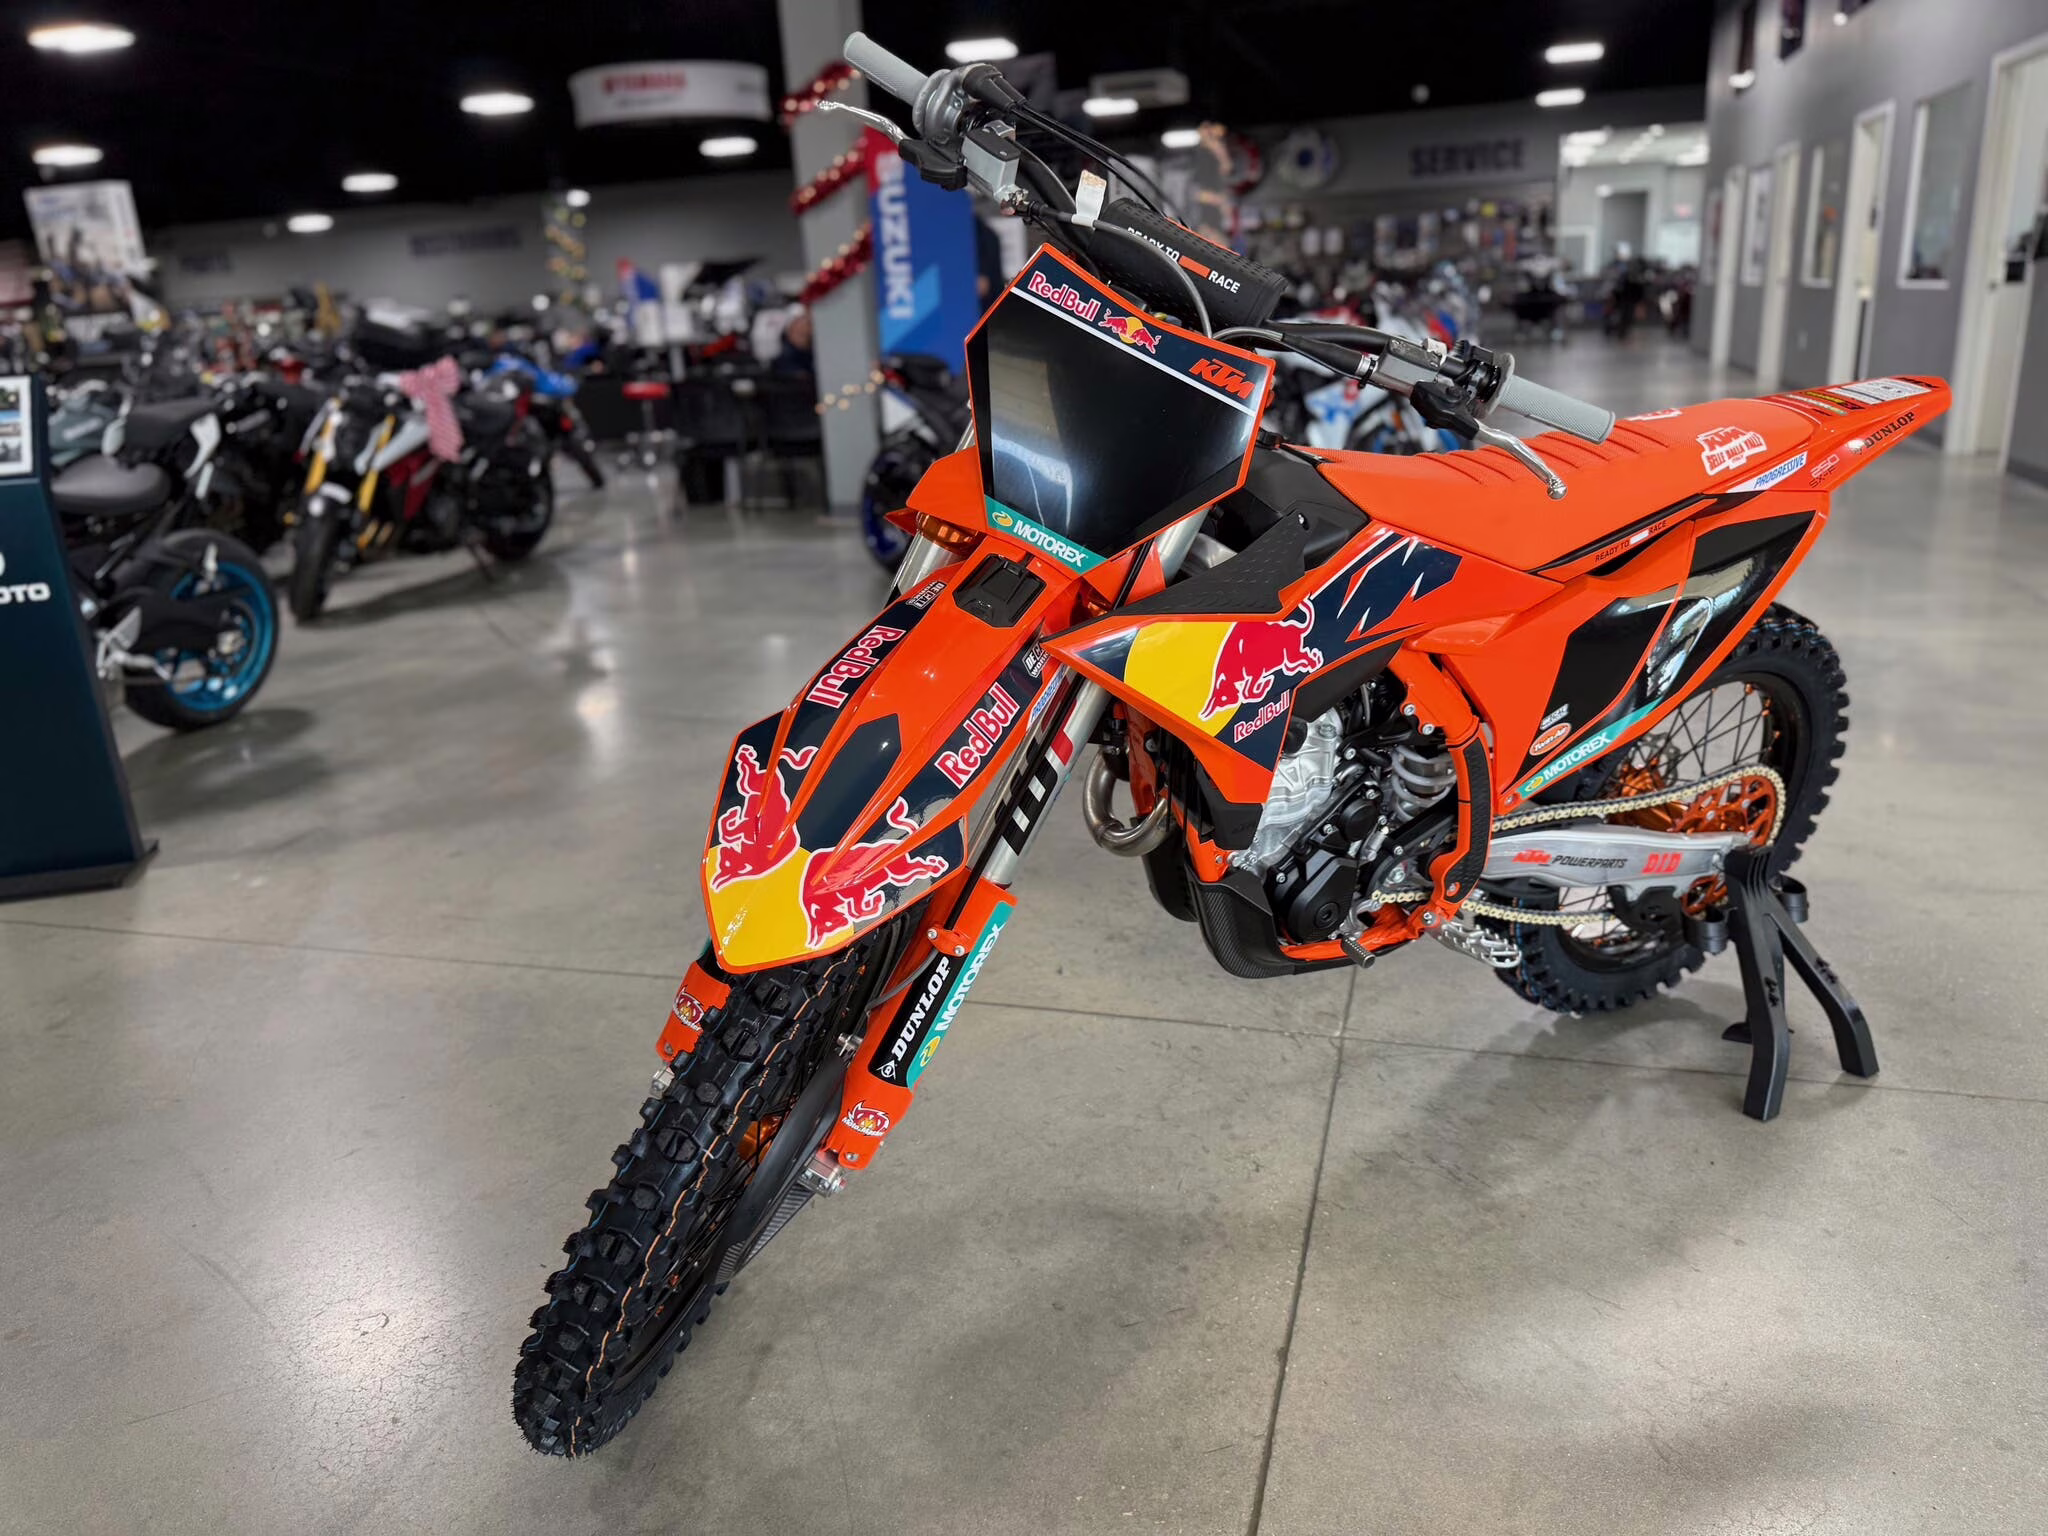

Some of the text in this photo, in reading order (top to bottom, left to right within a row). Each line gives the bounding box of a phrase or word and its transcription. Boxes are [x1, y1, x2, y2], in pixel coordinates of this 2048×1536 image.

[1409, 140, 1523, 177] SERVICE
[875, 152, 915, 320] SUZUKI
[1208, 270, 1241, 294] RACE
[1189, 358, 1256, 400] KTM
[1865, 411, 1915, 449] DUNLOP
[1753, 453, 1805, 489] PROGRESSIVE
[1811, 453, 1840, 478] 250
[1013, 519, 1087, 568] MOTOREX
[1595, 520, 1667, 562] READY TO RACE
[1543, 731, 1612, 780] MOTOREX
[1512, 849, 1628, 869] KTM POWERPARTS
[935, 923, 1006, 1031] MOTOREX
[892, 956, 950, 1061] DUNLOP
